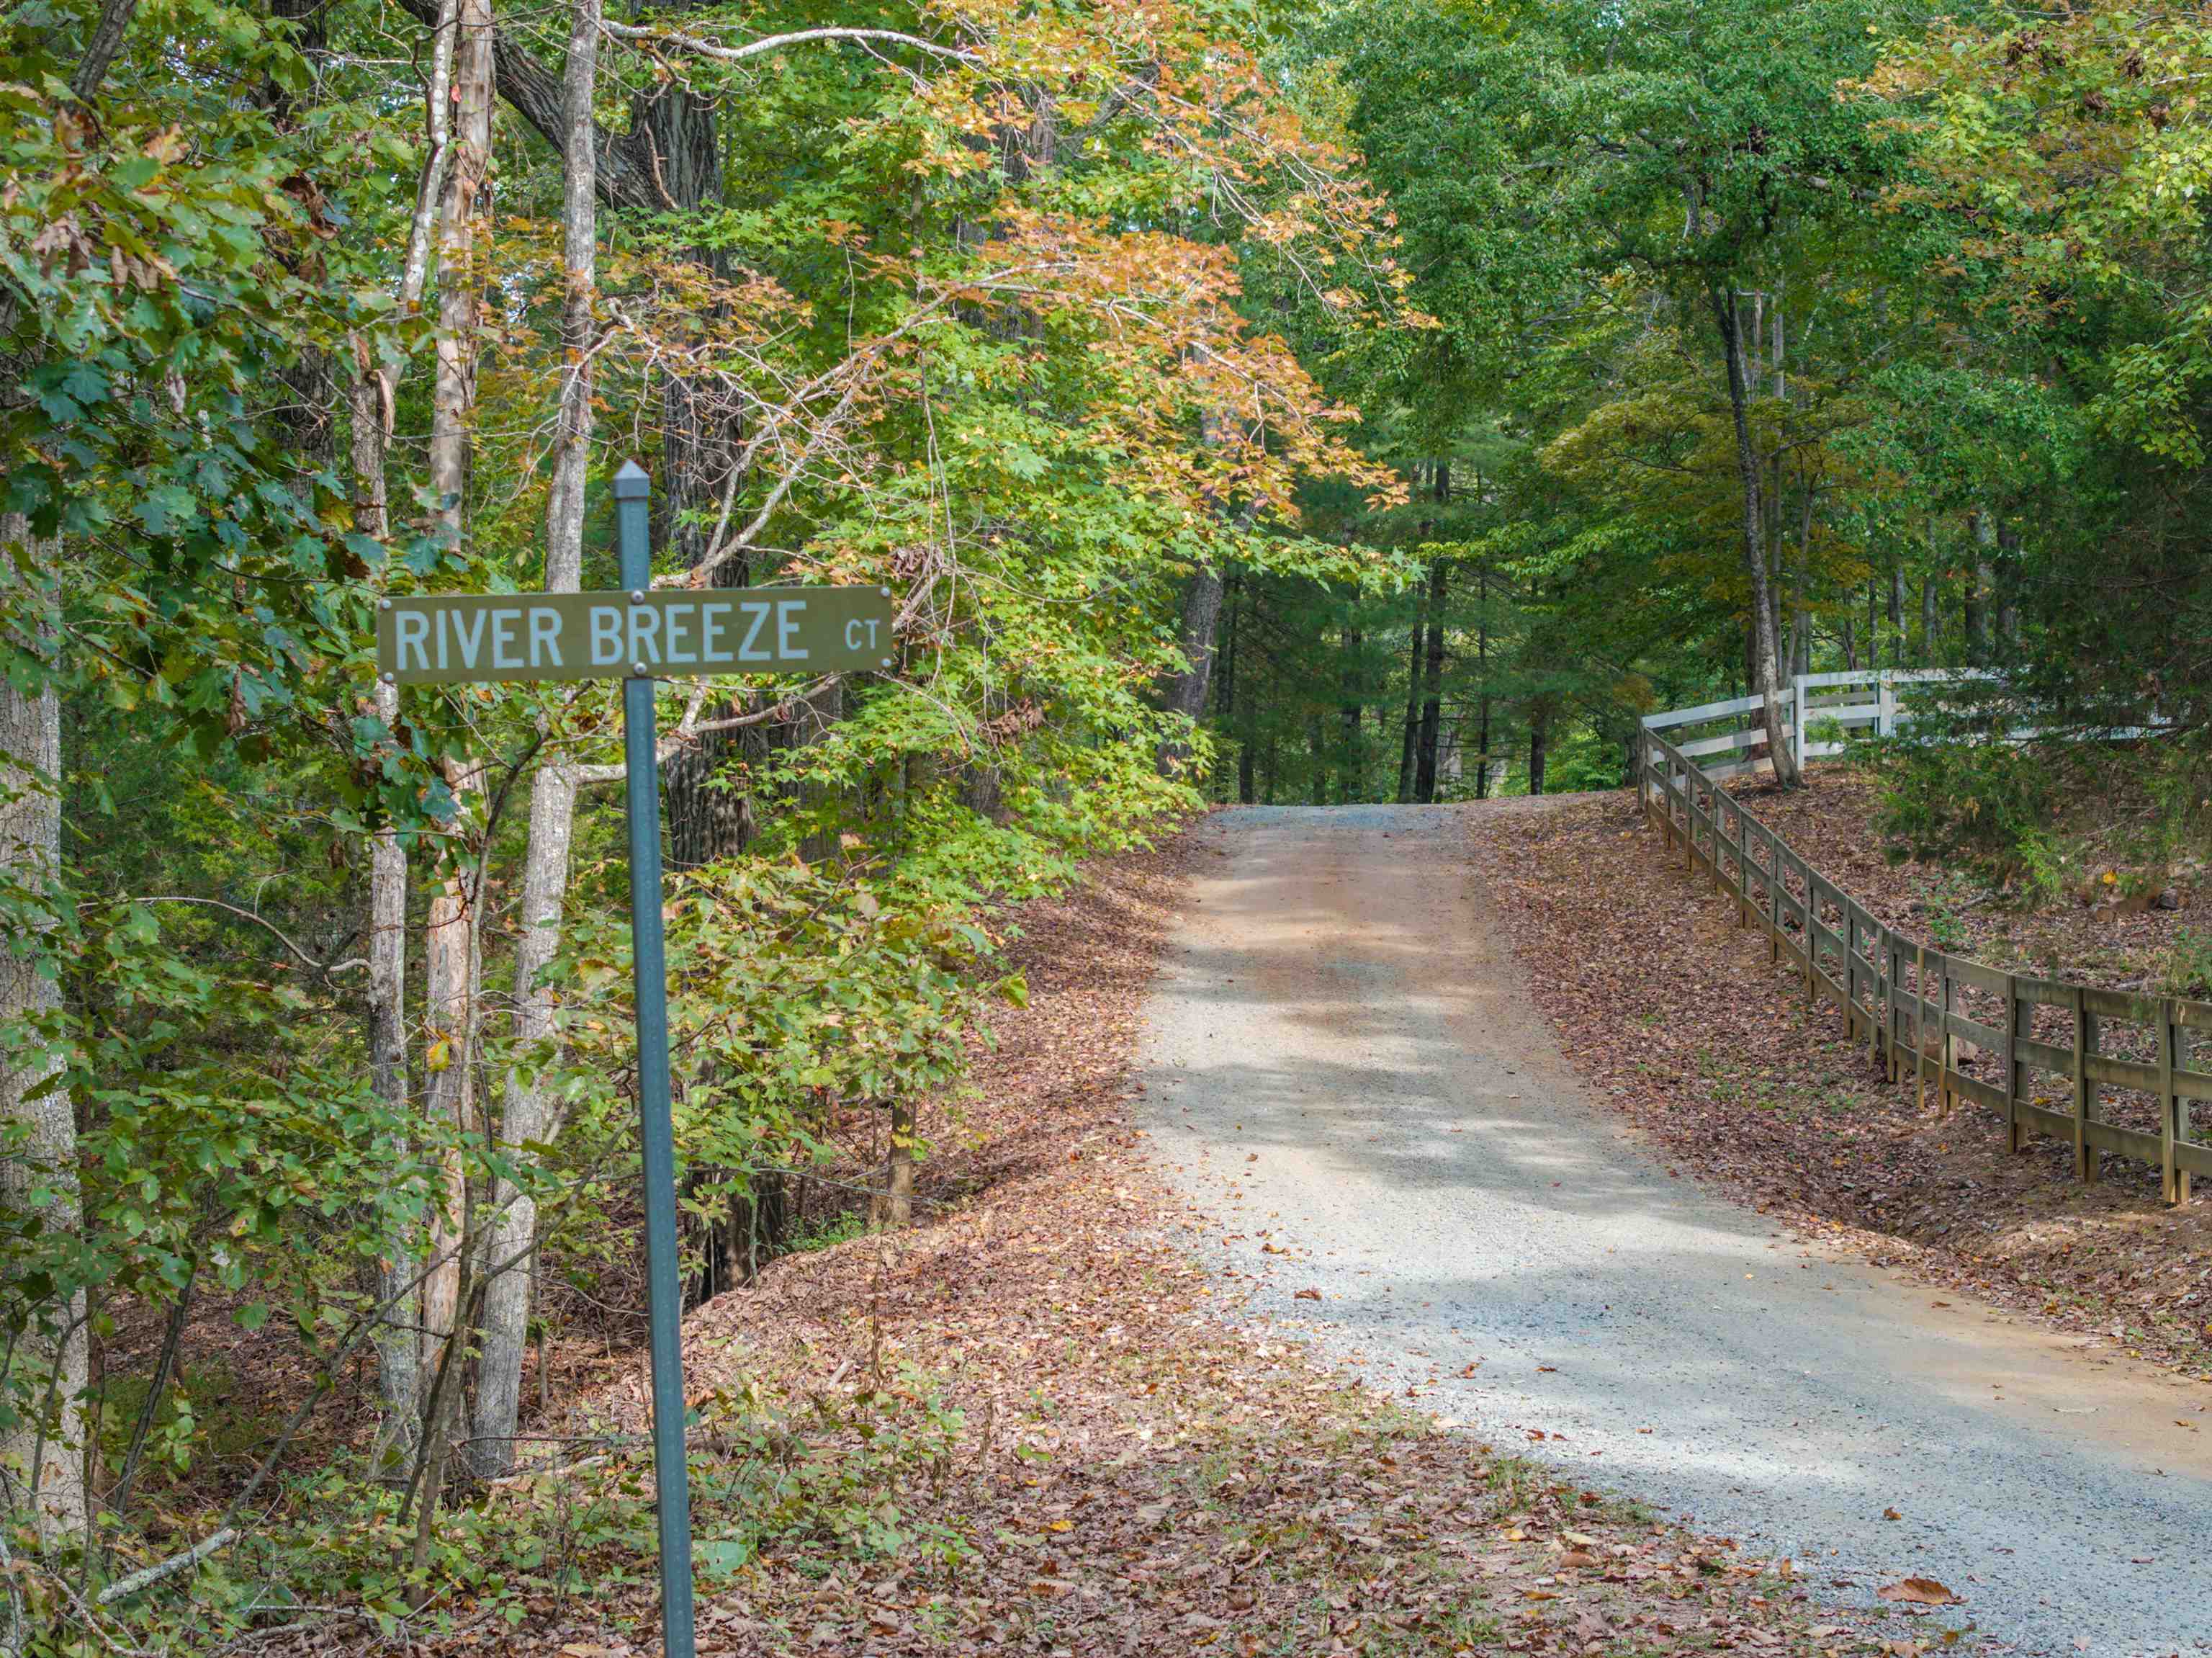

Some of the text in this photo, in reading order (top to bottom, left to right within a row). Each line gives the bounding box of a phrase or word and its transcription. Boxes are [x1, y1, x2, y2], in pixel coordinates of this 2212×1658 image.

[395, 601, 880, 670] RIVER BREEZE CT
